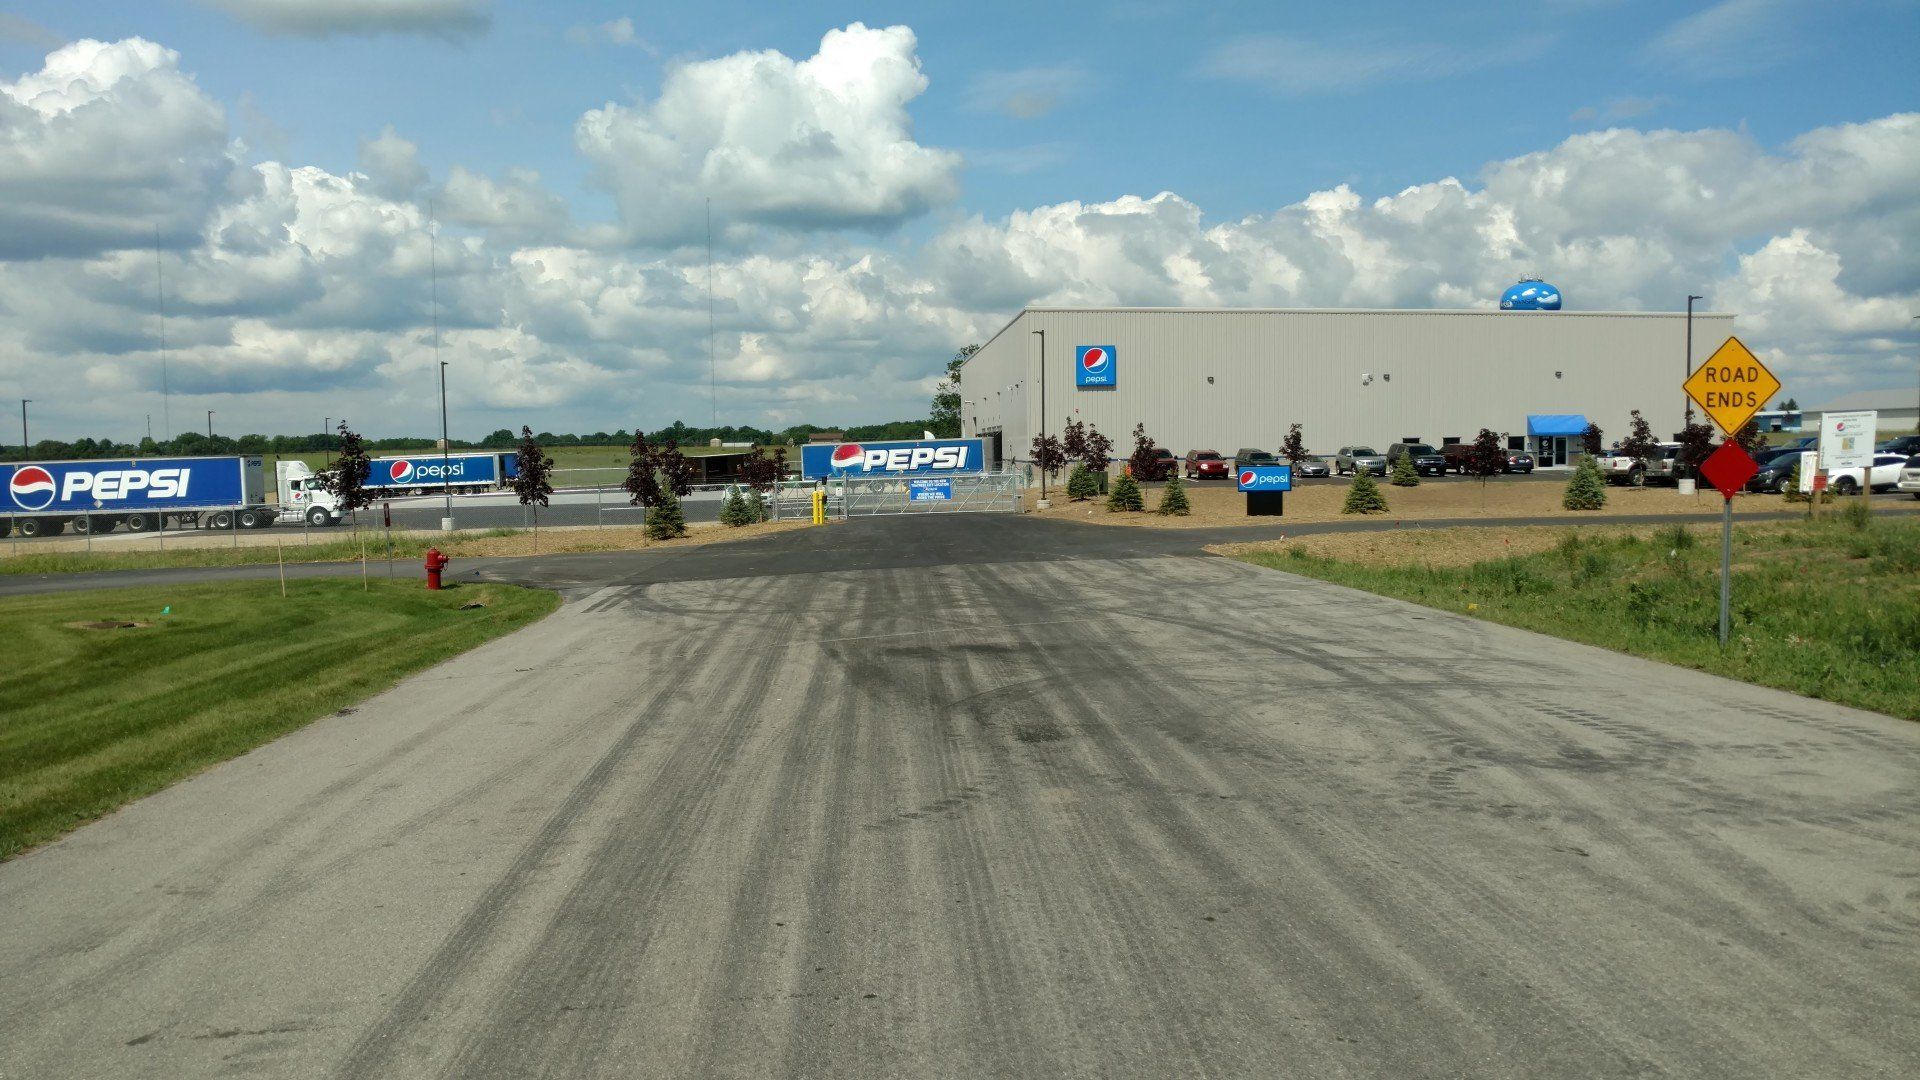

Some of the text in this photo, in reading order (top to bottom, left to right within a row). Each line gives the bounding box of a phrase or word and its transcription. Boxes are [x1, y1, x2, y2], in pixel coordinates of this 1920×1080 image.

[1085, 375, 1107, 384] pepsi
[1706, 367, 1759, 383] ROAD
[1706, 391, 1757, 407] ENDS
[862, 446, 969, 472] PEPSI
[416, 462, 464, 480] pepsi
[1259, 473, 1288, 485] pepsi
[61, 468, 191, 501] PEPSI
